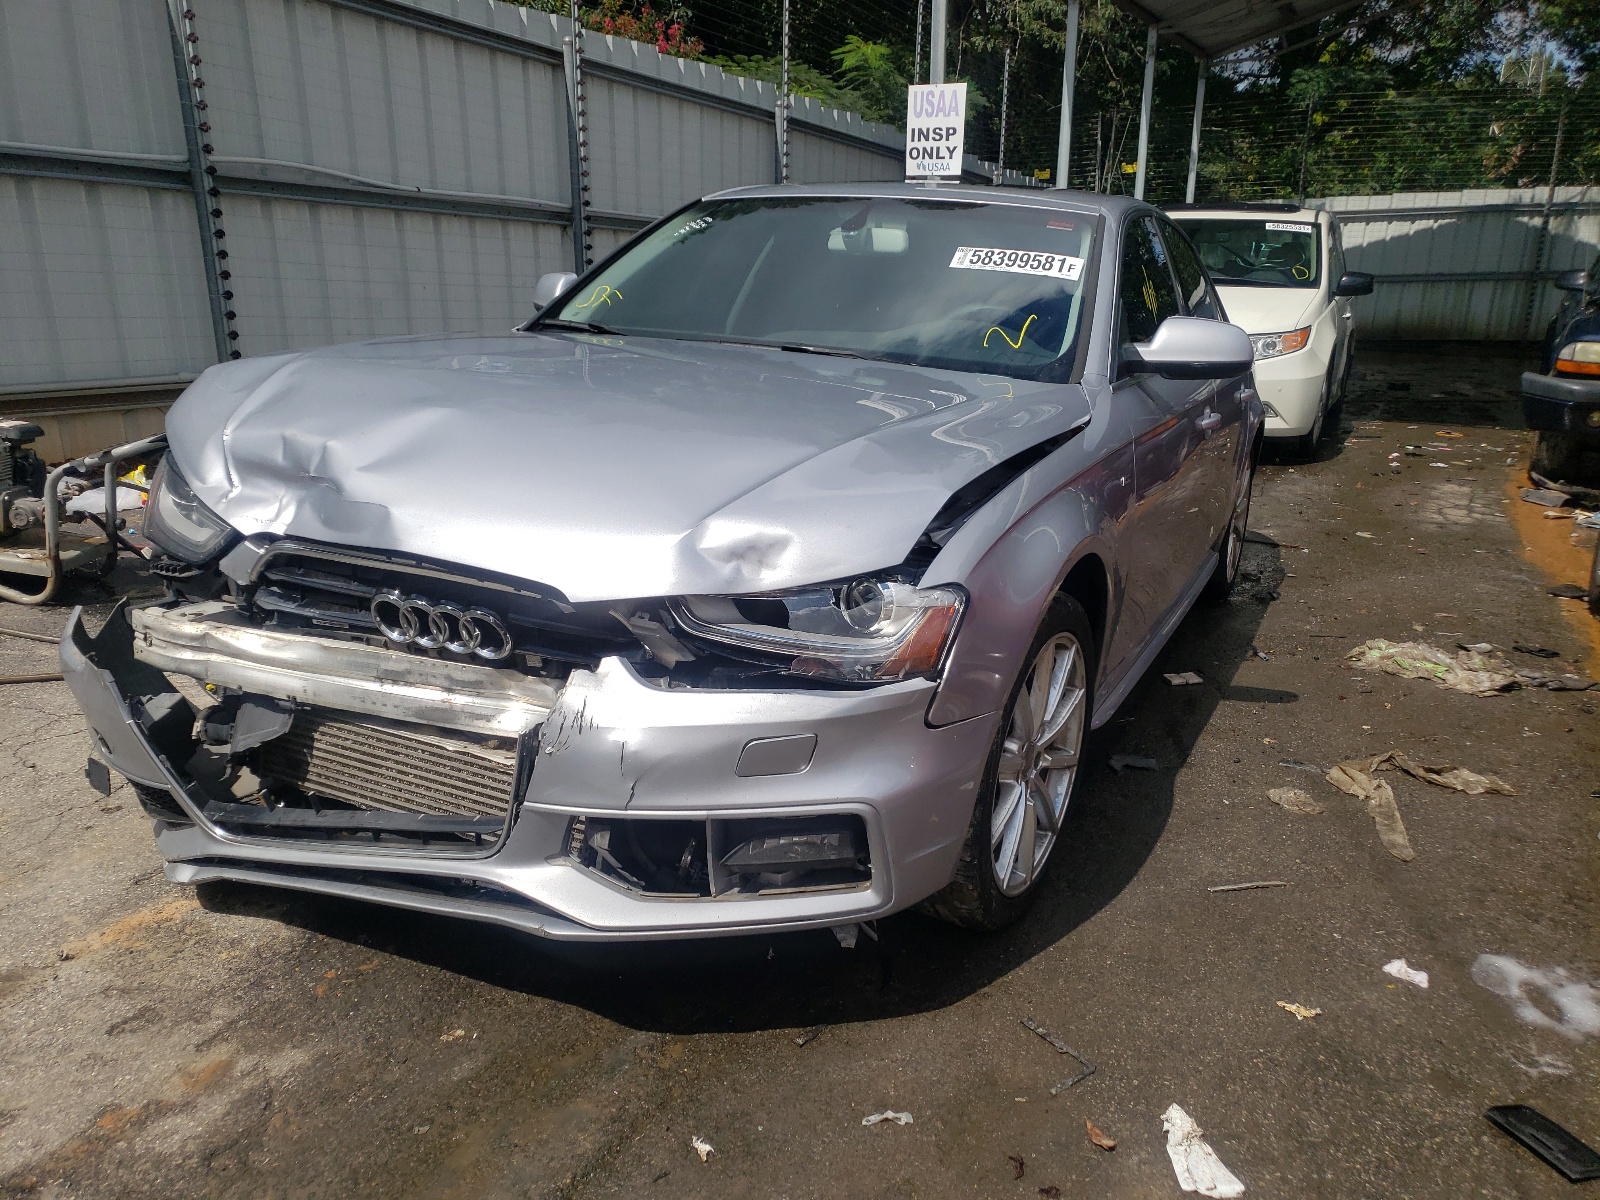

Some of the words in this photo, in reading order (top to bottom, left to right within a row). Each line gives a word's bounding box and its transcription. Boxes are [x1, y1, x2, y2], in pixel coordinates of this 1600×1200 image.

[913, 89, 960, 118] USAA
[910, 126, 957, 143] INSP
[908, 145, 958, 160] ONLY
[927, 162, 951, 172] USAA
[969, 249, 1067, 273] 58399581
